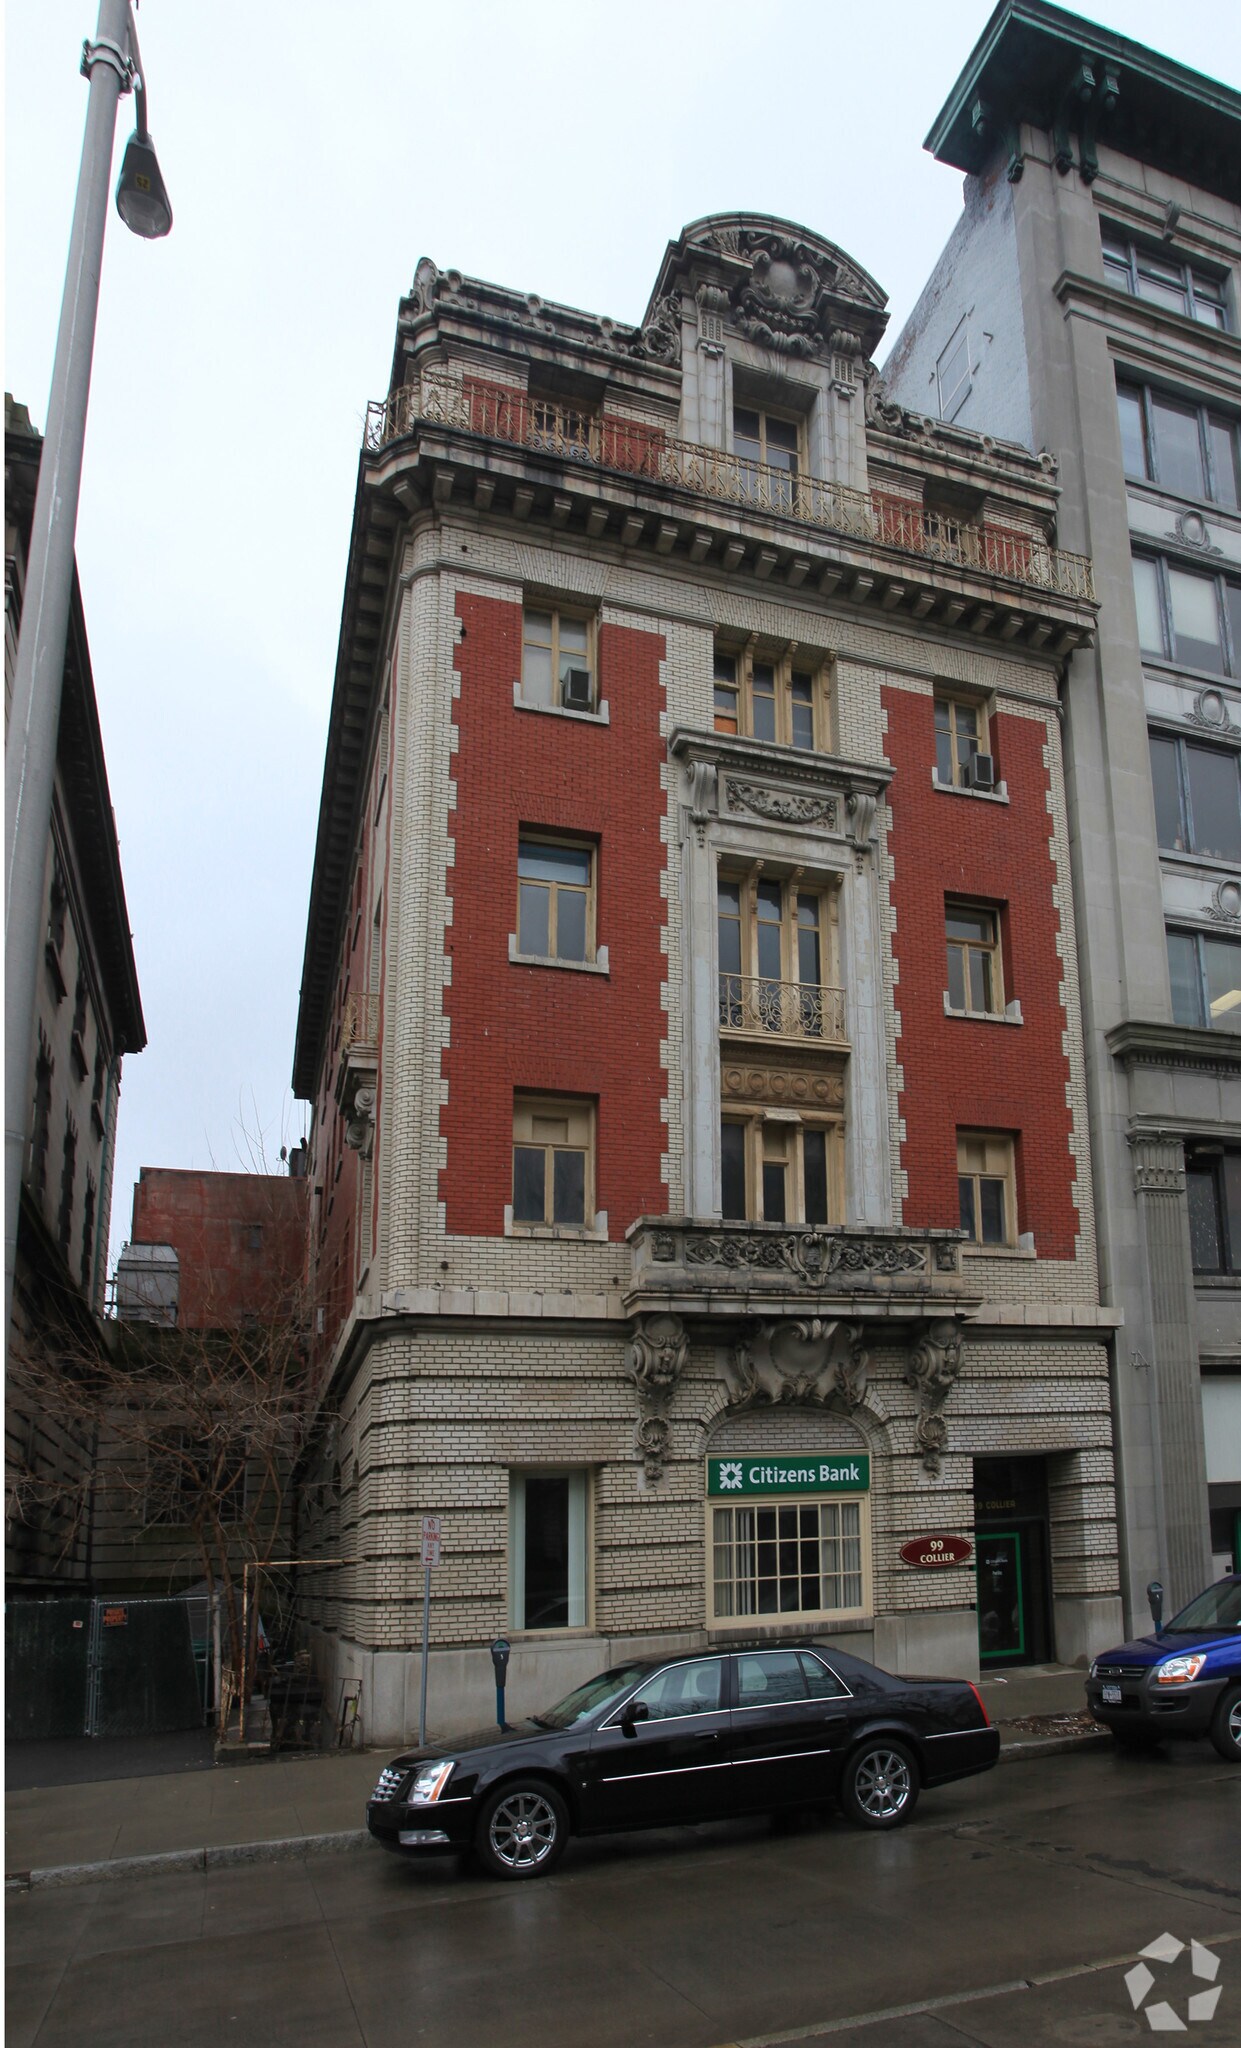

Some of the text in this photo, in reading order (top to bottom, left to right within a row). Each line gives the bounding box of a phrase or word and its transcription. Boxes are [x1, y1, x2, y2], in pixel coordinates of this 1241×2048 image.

[749, 1463, 860, 1484] Citizens Bank
[985, 1499, 1016, 1510] COLLIER
[427, 1519, 436, 1530] NO
[423, 1531, 440, 1541] PARKING
[930, 1541, 944, 1552] 99
[920, 1553, 955, 1563] COLLIER
